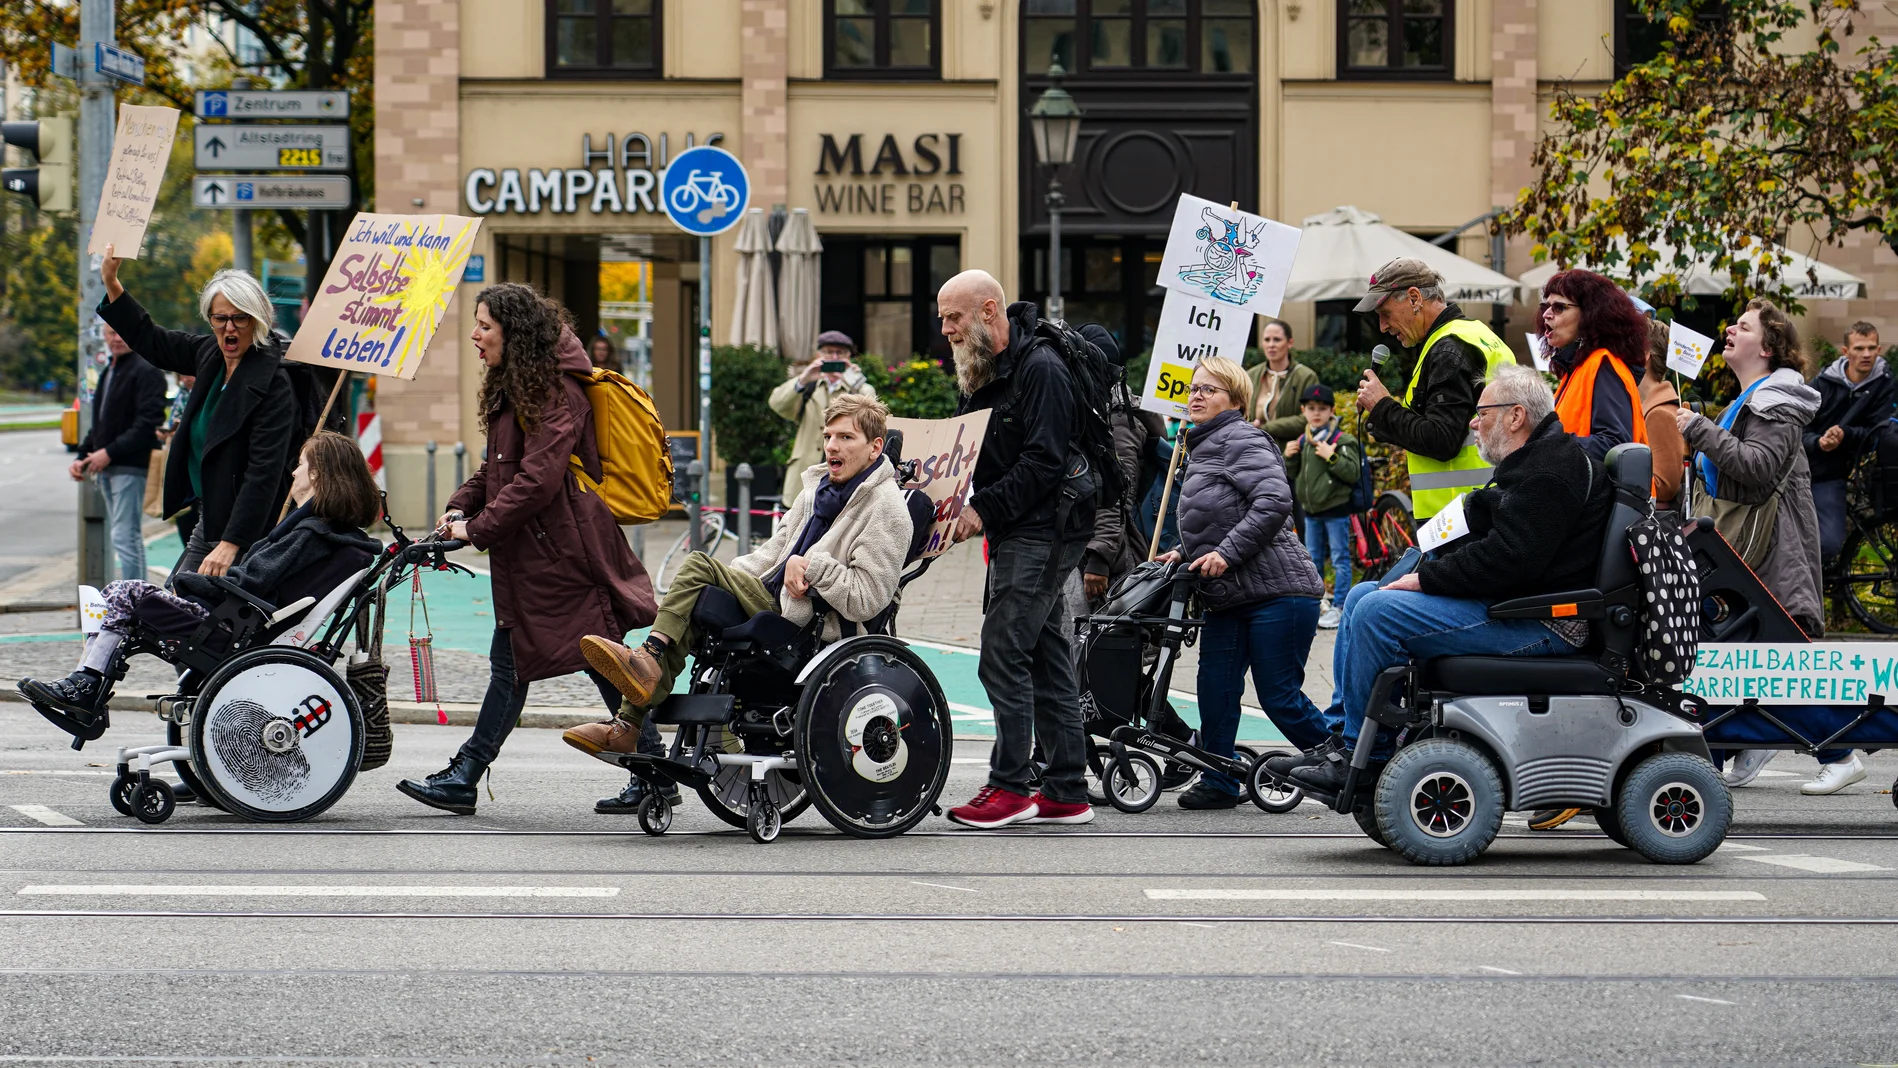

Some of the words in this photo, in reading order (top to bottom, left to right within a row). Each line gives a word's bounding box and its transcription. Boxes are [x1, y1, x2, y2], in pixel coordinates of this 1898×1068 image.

[234, 96, 301, 111] Zentrum
[240, 131, 323, 147] Altstadtring
[583, 133, 724, 168] HAU
[814, 133, 963, 175] MASI
[814, 183, 896, 213] WINE
[907, 183, 965, 213] BAR
[350, 220, 371, 242] Ich
[371, 222, 400, 246] will
[394, 226, 419, 247] und
[417, 226, 450, 250] kann
[326, 251, 412, 295] Selbstbe
[1458, 287, 1500, 301] MASI
[1801, 283, 1844, 297] MASI
[339, 292, 403, 332] stimmt
[1188, 305, 1221, 331] Ich
[1177, 343, 1219, 361] will
[1157, 371, 1190, 399] Sp
[1696, 648, 1844, 671] EZAHLBARER
[1872, 657, 1898, 692] W
[1683, 676, 1868, 702] BARRIEREFREIER
